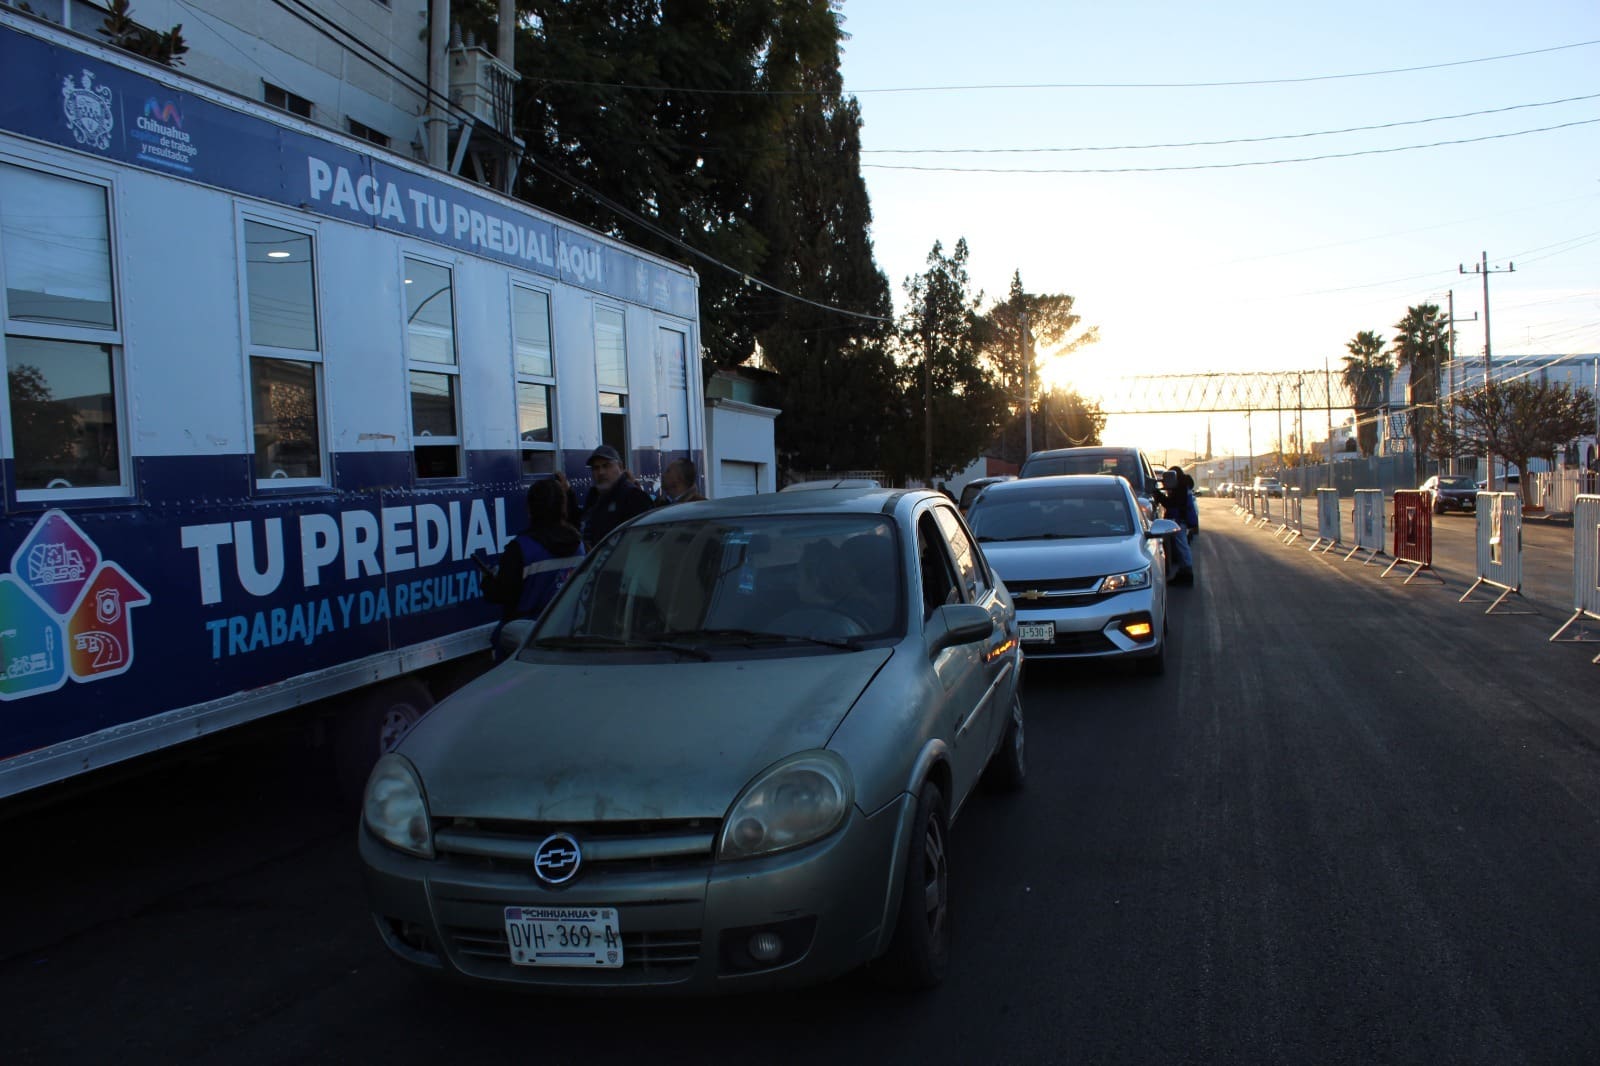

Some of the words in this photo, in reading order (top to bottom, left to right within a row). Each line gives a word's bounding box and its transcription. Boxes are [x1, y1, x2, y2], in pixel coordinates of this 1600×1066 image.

[136, 116, 190, 143] Chihuahua
[142, 143, 148, 153] y
[148, 145, 189, 163] resultados
[160, 136, 170, 148] de
[171, 140, 198, 157] trabajo
[308, 156, 406, 224] PAGA
[409, 188, 448, 235] TU
[453, 203, 554, 267] PREDIAL
[180, 517, 285, 606] TU
[299, 497, 518, 588] PREDIAL
[205, 598, 335, 660] TRABAJA
[337, 592, 356, 630] Y
[359, 587, 392, 625] DA
[395, 569, 484, 617] RESULTA
[531, 909, 590, 919] CHIHUAHUA
[510, 923, 618, 949] DVH-369-A
